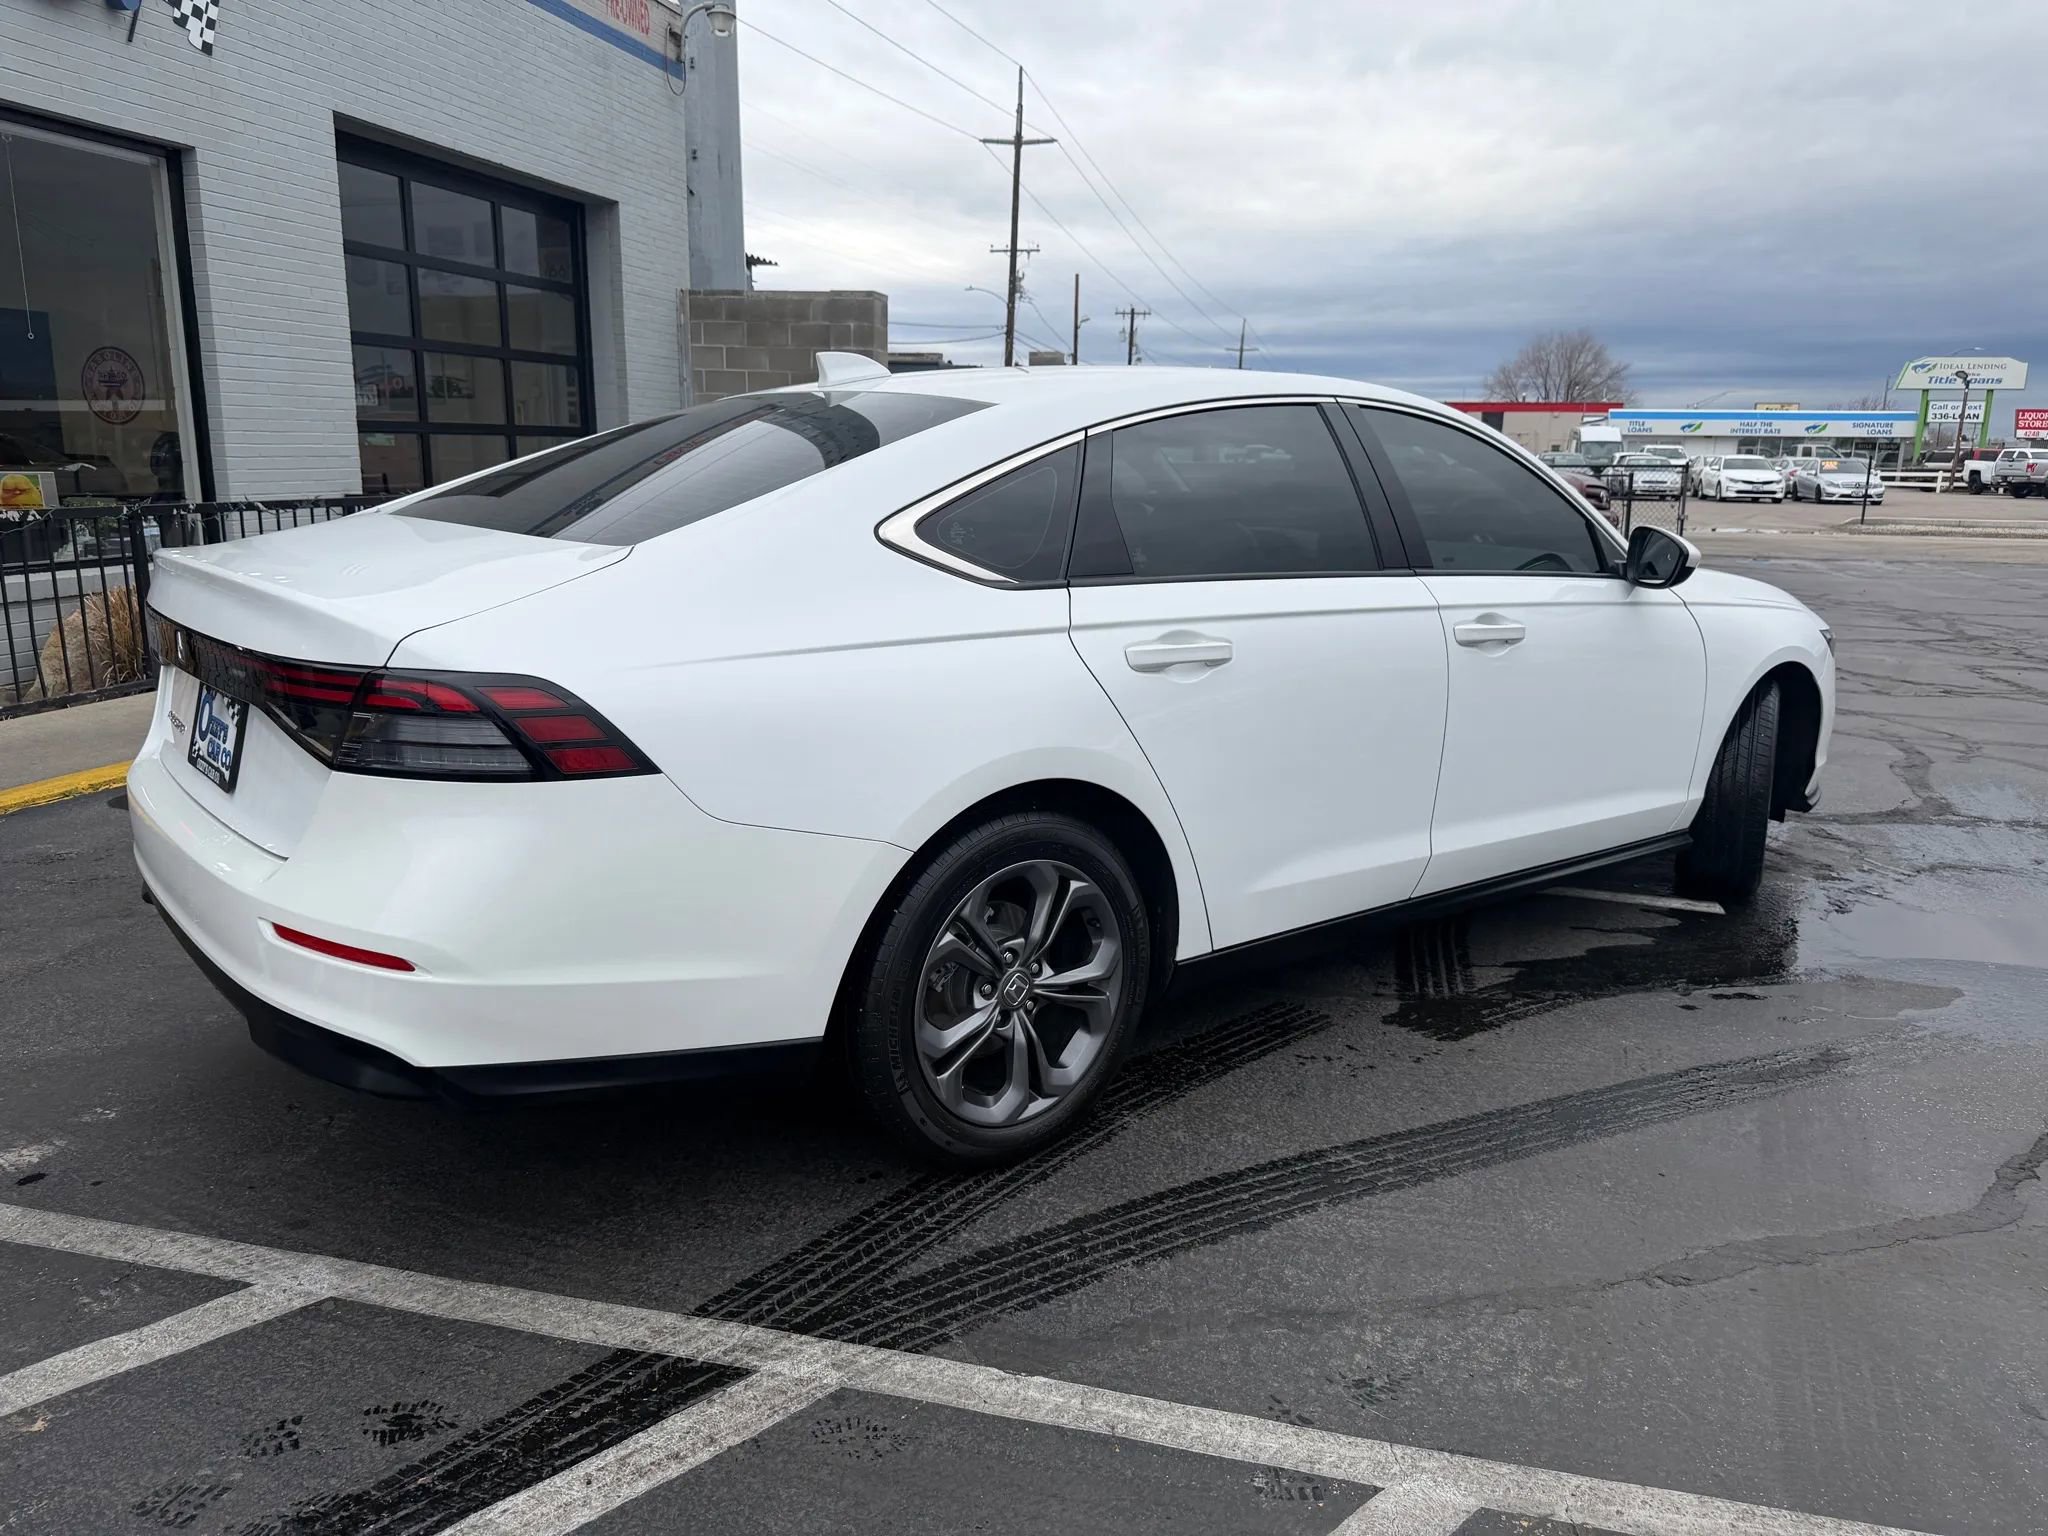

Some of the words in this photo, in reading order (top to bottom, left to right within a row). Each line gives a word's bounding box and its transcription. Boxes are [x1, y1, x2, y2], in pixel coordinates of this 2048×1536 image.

[1928, 376, 1957, 385] Title
[1962, 376, 2003, 385] oans
[1931, 403, 1949, 411] Call
[1965, 403, 1982, 411] ext
